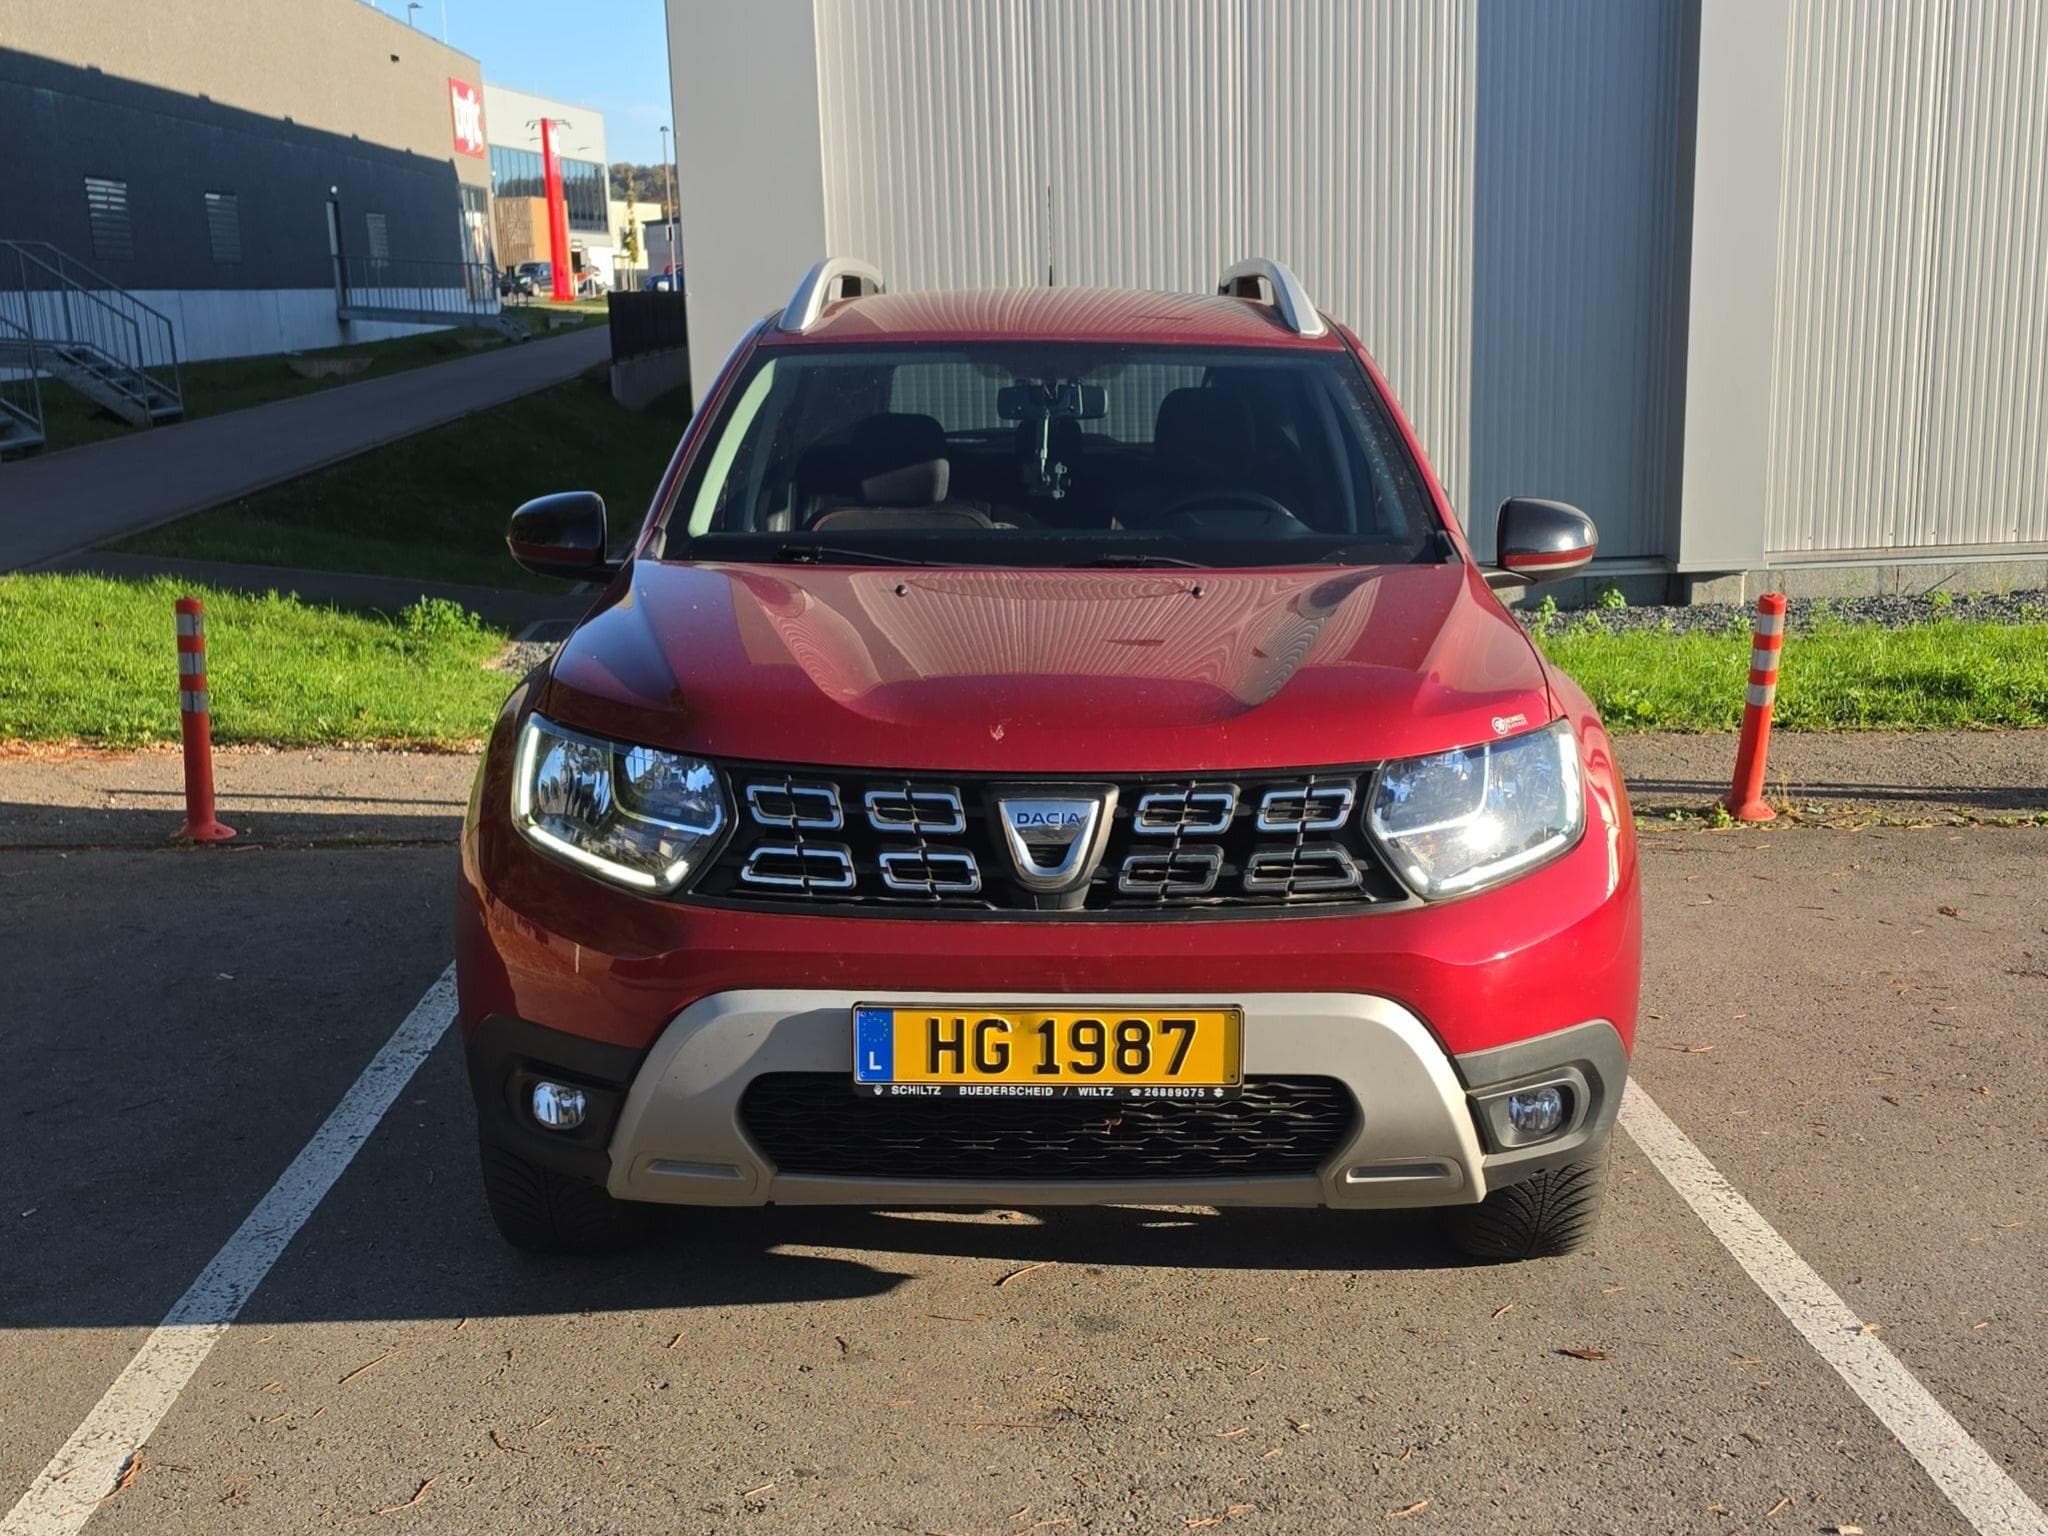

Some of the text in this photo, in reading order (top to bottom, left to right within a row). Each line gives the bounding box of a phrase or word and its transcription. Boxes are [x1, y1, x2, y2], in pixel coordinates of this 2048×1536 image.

[1017, 813, 1080, 824] DACIA
[928, 1018, 1198, 1075] HG 1987
[869, 1051, 882, 1070] L
[891, 1086, 941, 1095] SCHILTZ
[959, 1086, 1054, 1096] BUEDERSCHEID
[1078, 1087, 1114, 1097] WILTZ
